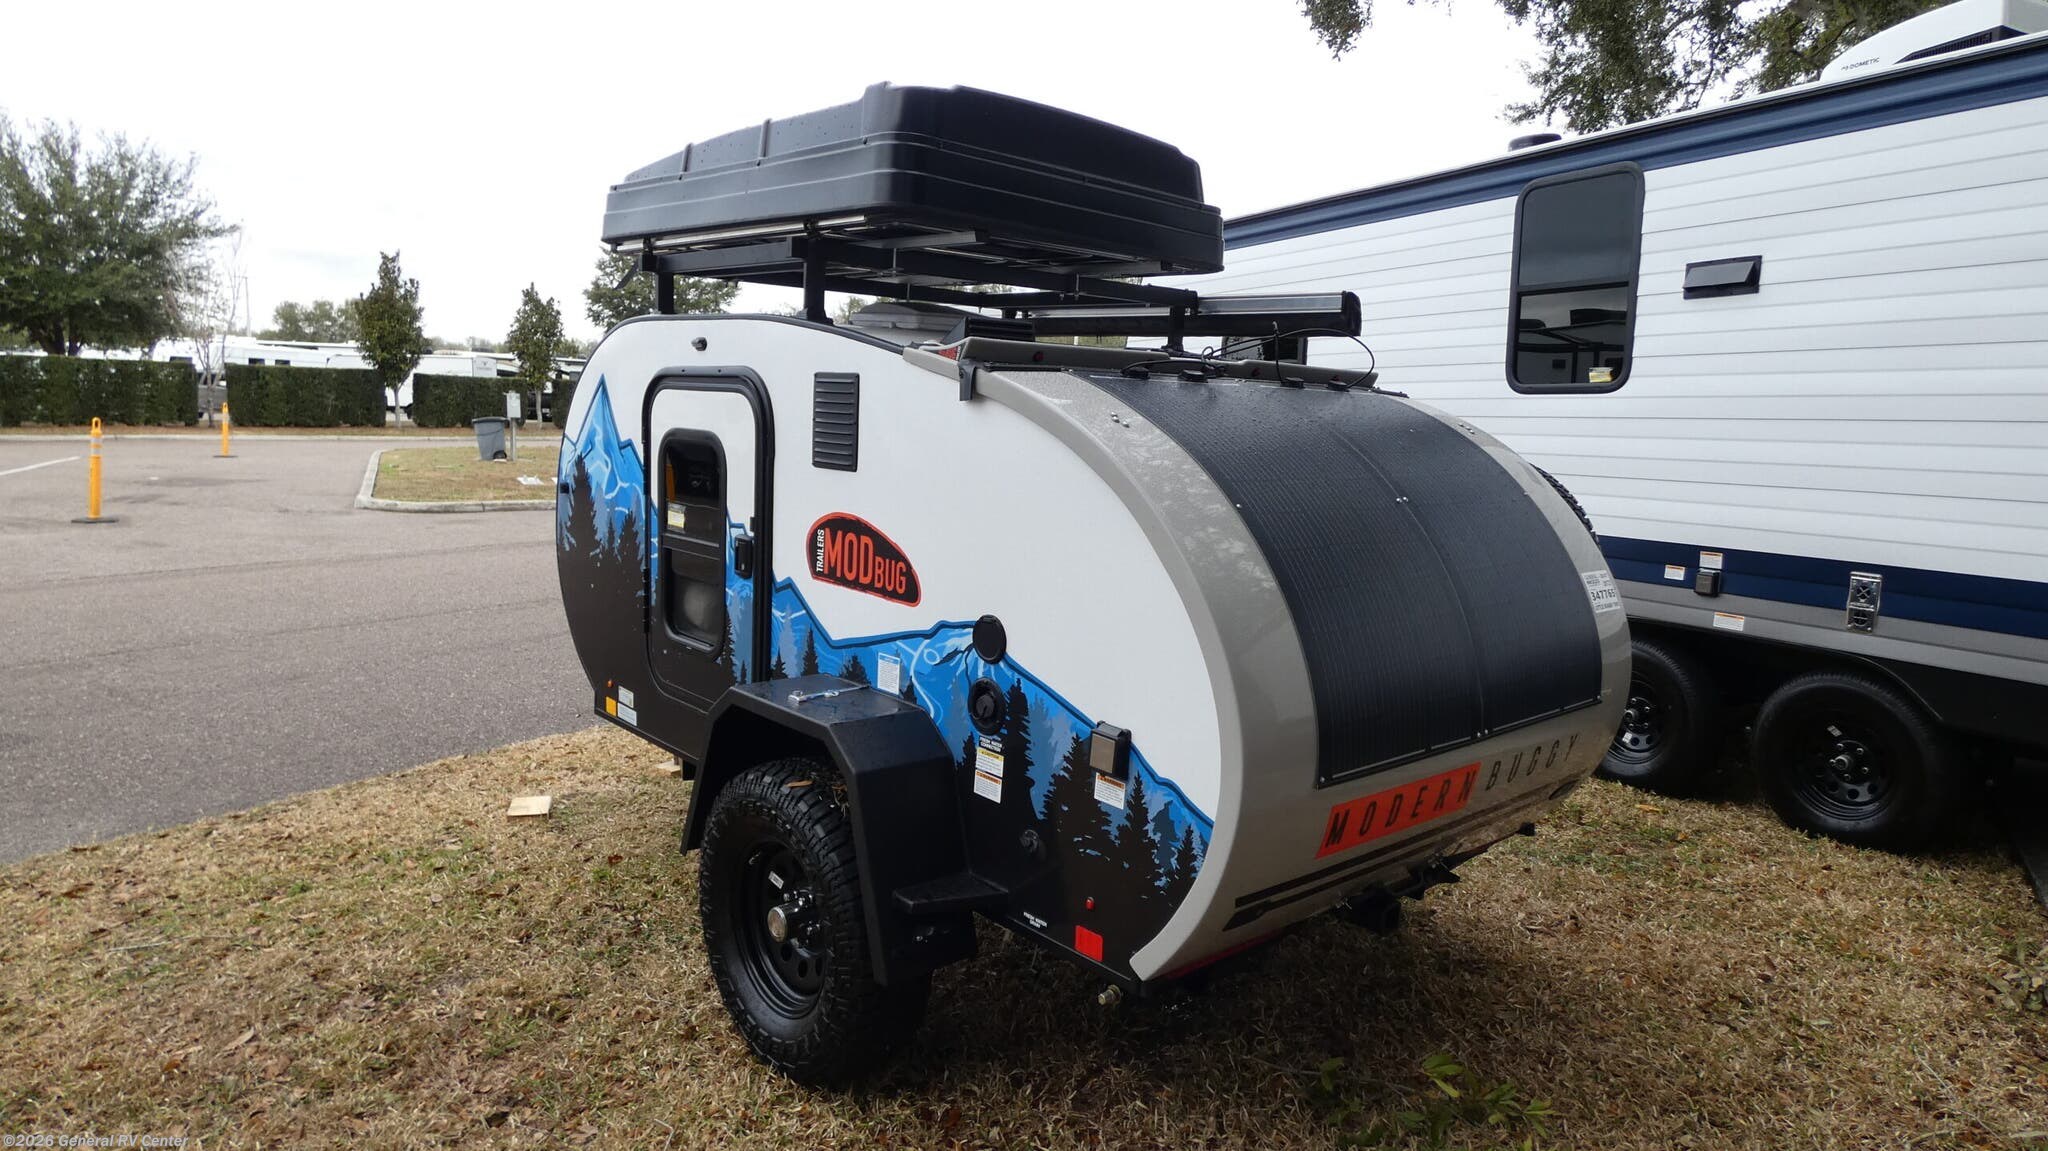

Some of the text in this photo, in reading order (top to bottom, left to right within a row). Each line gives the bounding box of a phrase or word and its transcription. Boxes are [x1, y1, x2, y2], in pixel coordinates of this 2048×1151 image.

[1850, 57, 1880, 69] DOMETIC
[816, 529, 825, 572] TRAILERS
[1325, 734, 1578, 848] MODERN BUGGY
